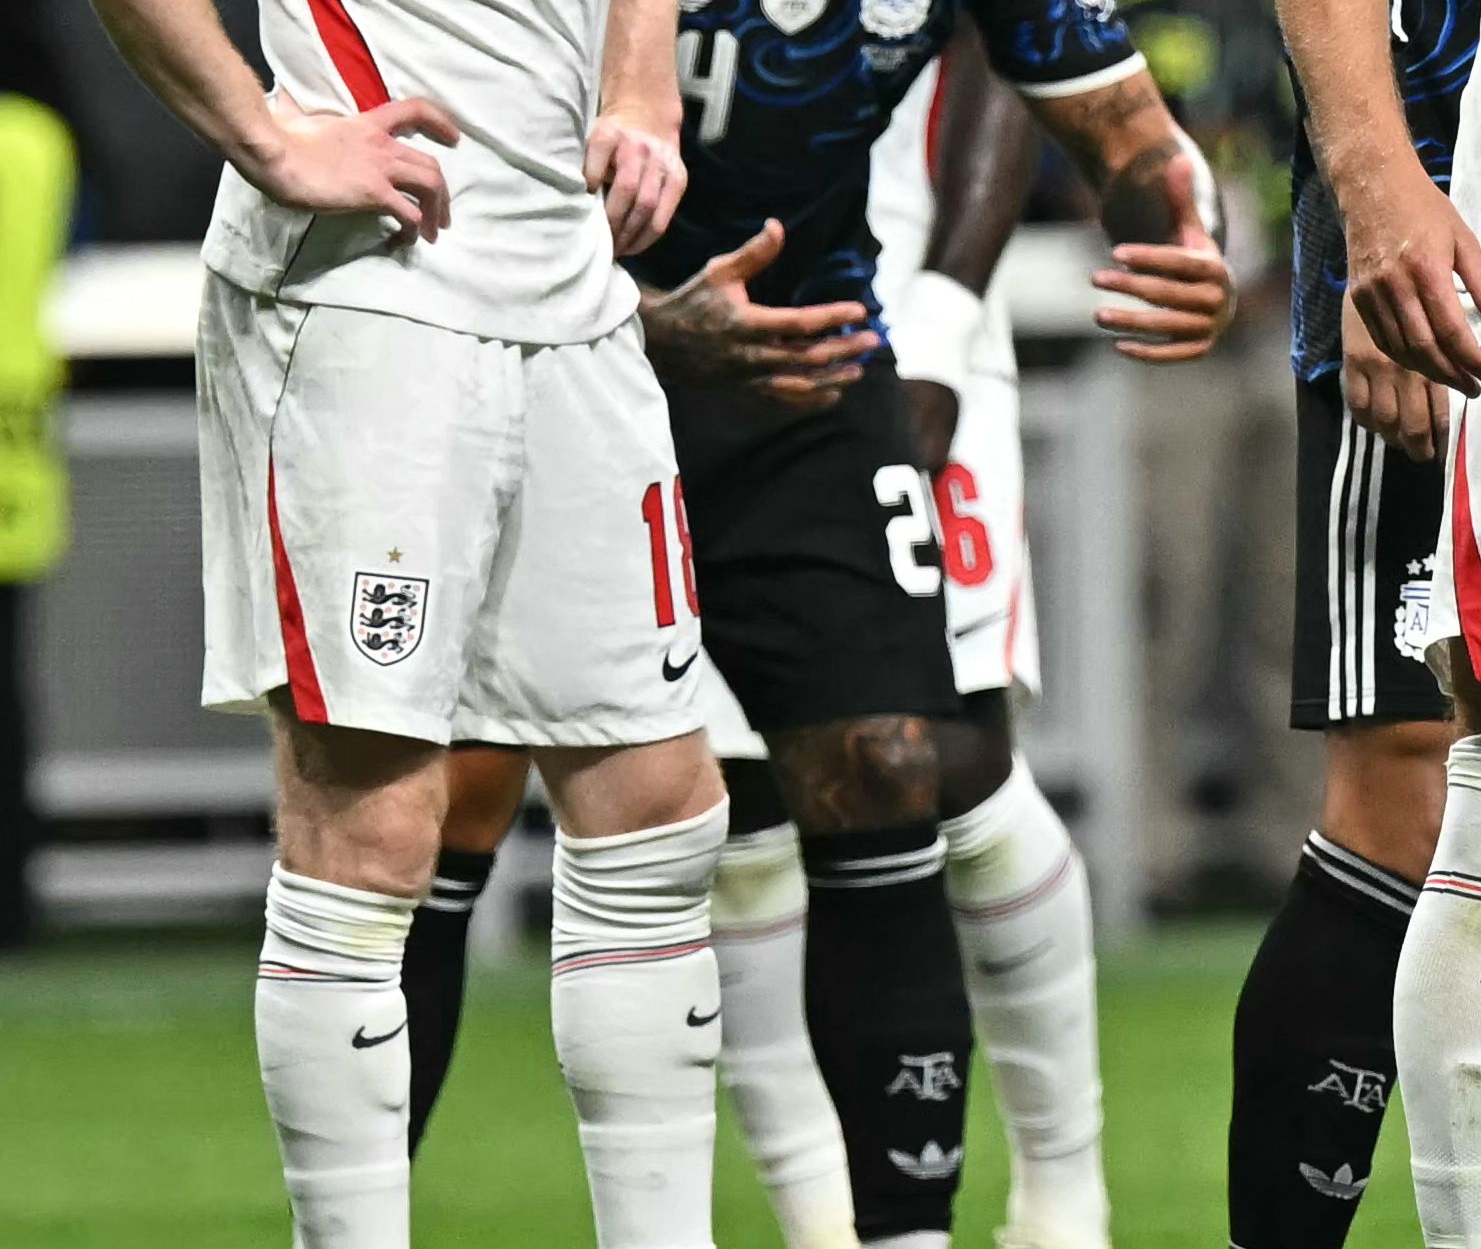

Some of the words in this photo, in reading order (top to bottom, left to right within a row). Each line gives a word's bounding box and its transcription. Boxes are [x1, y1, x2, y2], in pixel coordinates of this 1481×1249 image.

[679, 29, 738, 143] 4
[872, 464, 942, 598] 2
[933, 461, 994, 587] 6
[1306, 1059, 1386, 1113] AFA
